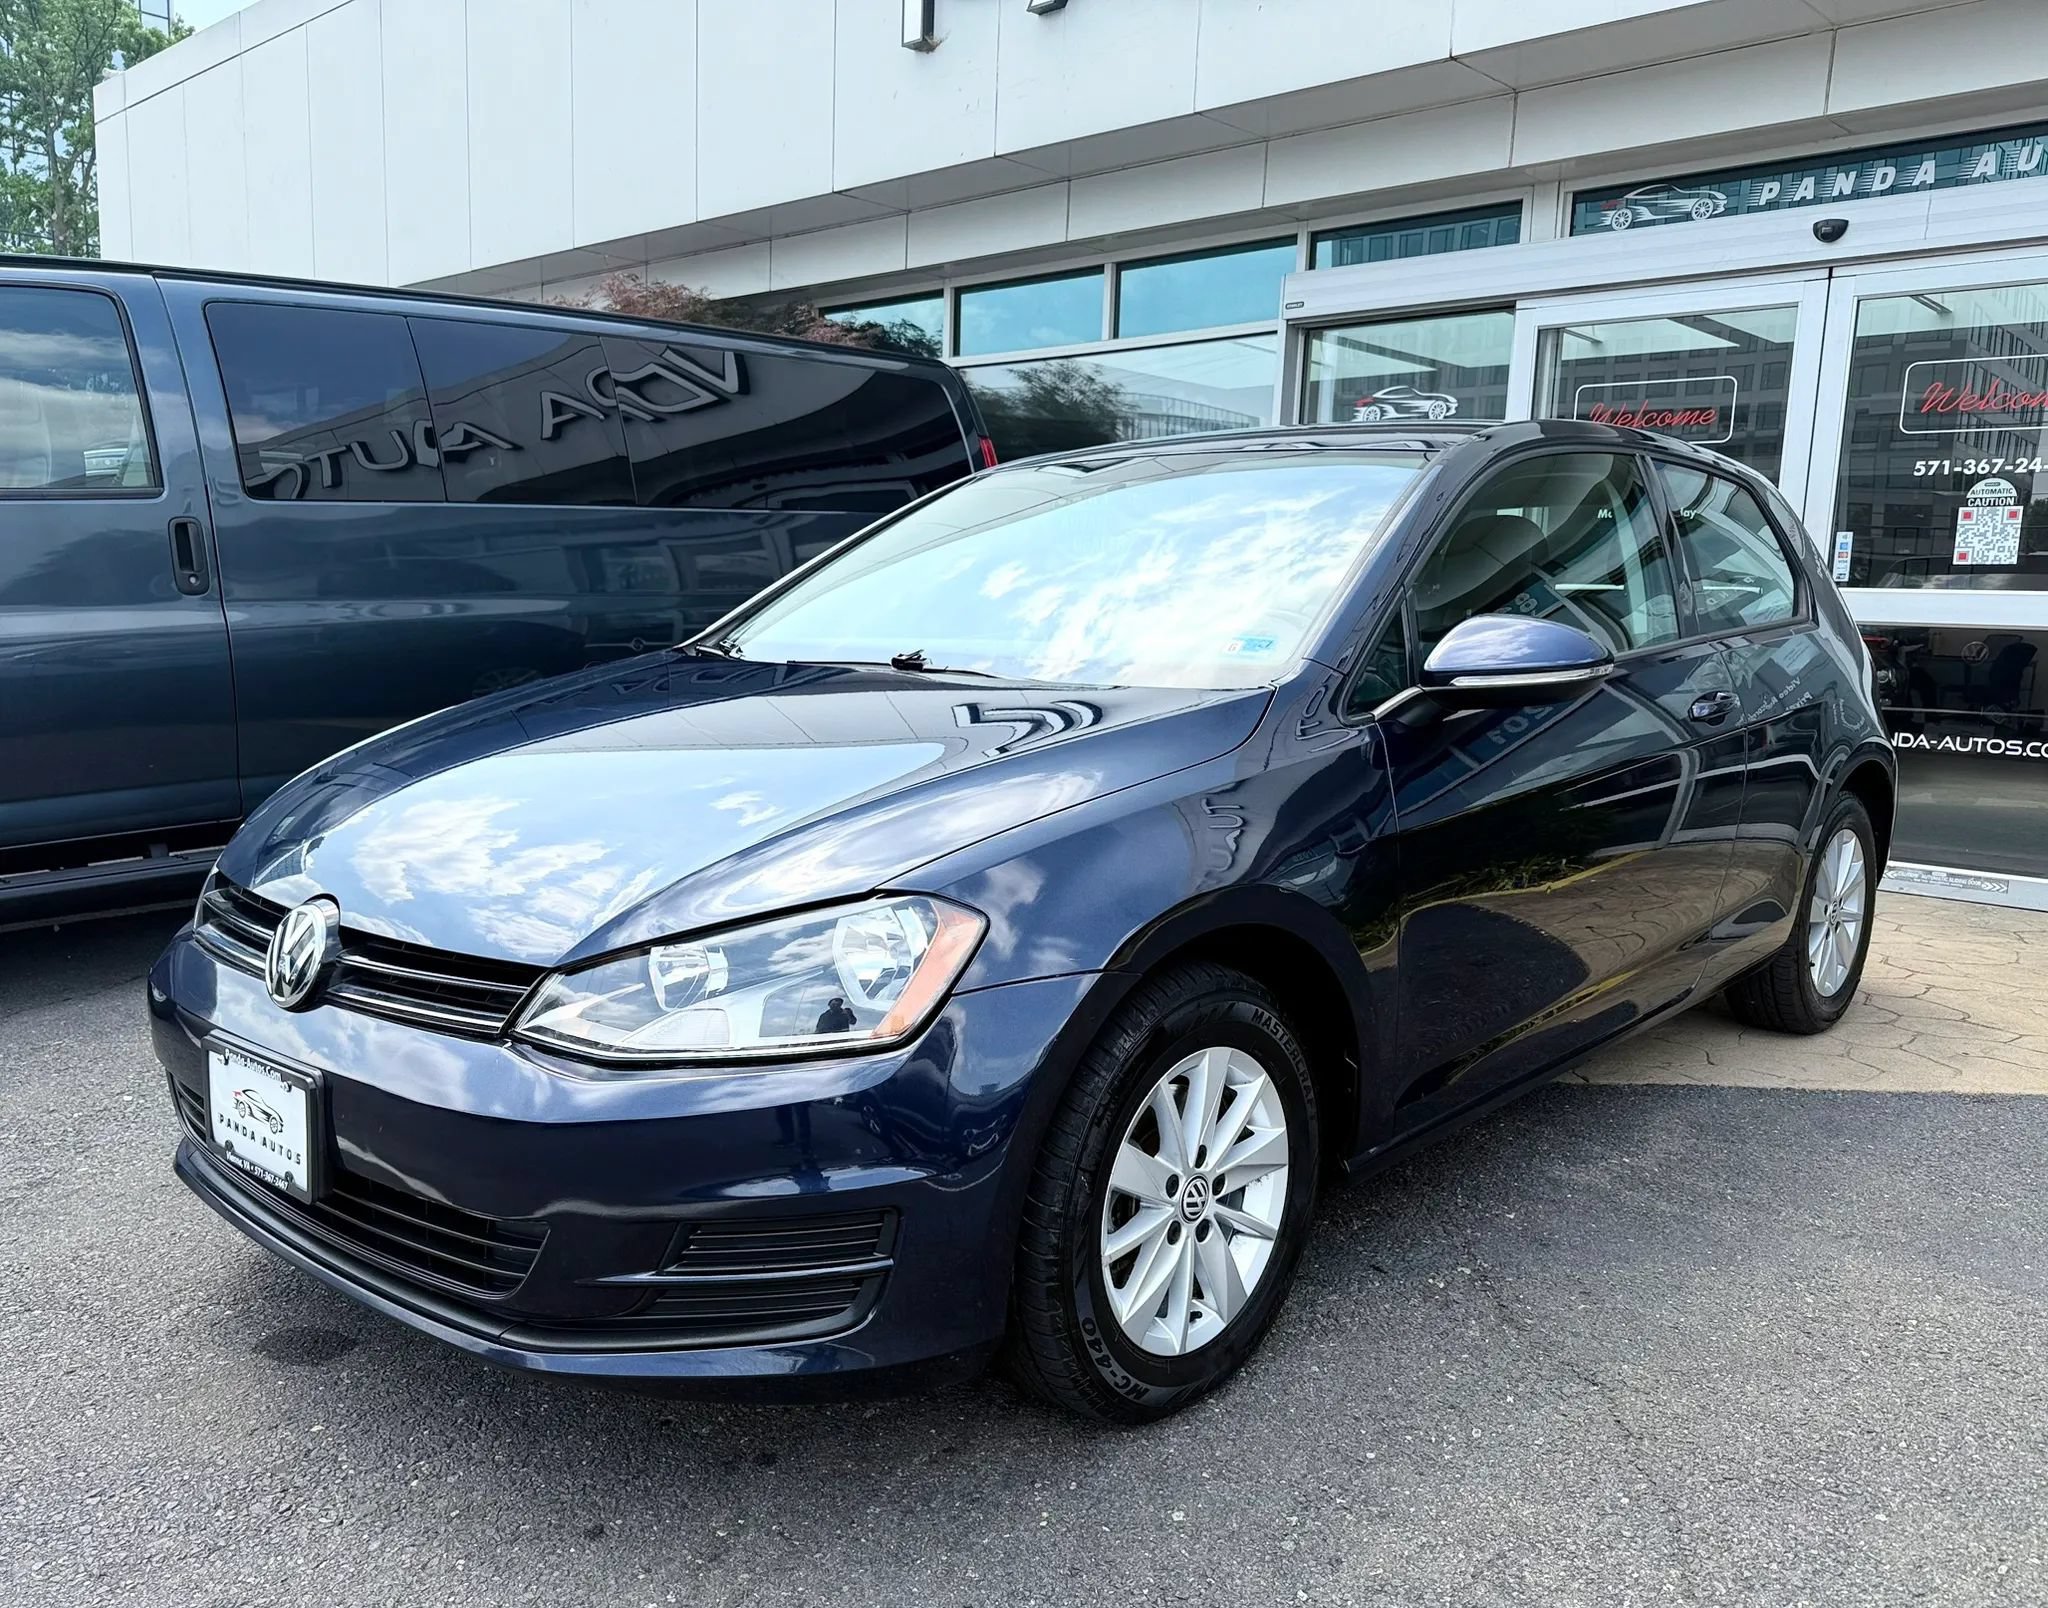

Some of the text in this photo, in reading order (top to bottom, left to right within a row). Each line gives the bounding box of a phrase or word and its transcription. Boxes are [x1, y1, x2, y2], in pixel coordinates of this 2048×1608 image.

[1756, 159, 1937, 206] PANDA
[1588, 399, 1718, 428] Welcome
[1967, 496, 2015, 507] CAUTION
[1970, 487, 2014, 496] AUTOMATIC
[217, 1112, 302, 1165] PANDA AUTOS
[1081, 1317, 1151, 1400] MC-440
